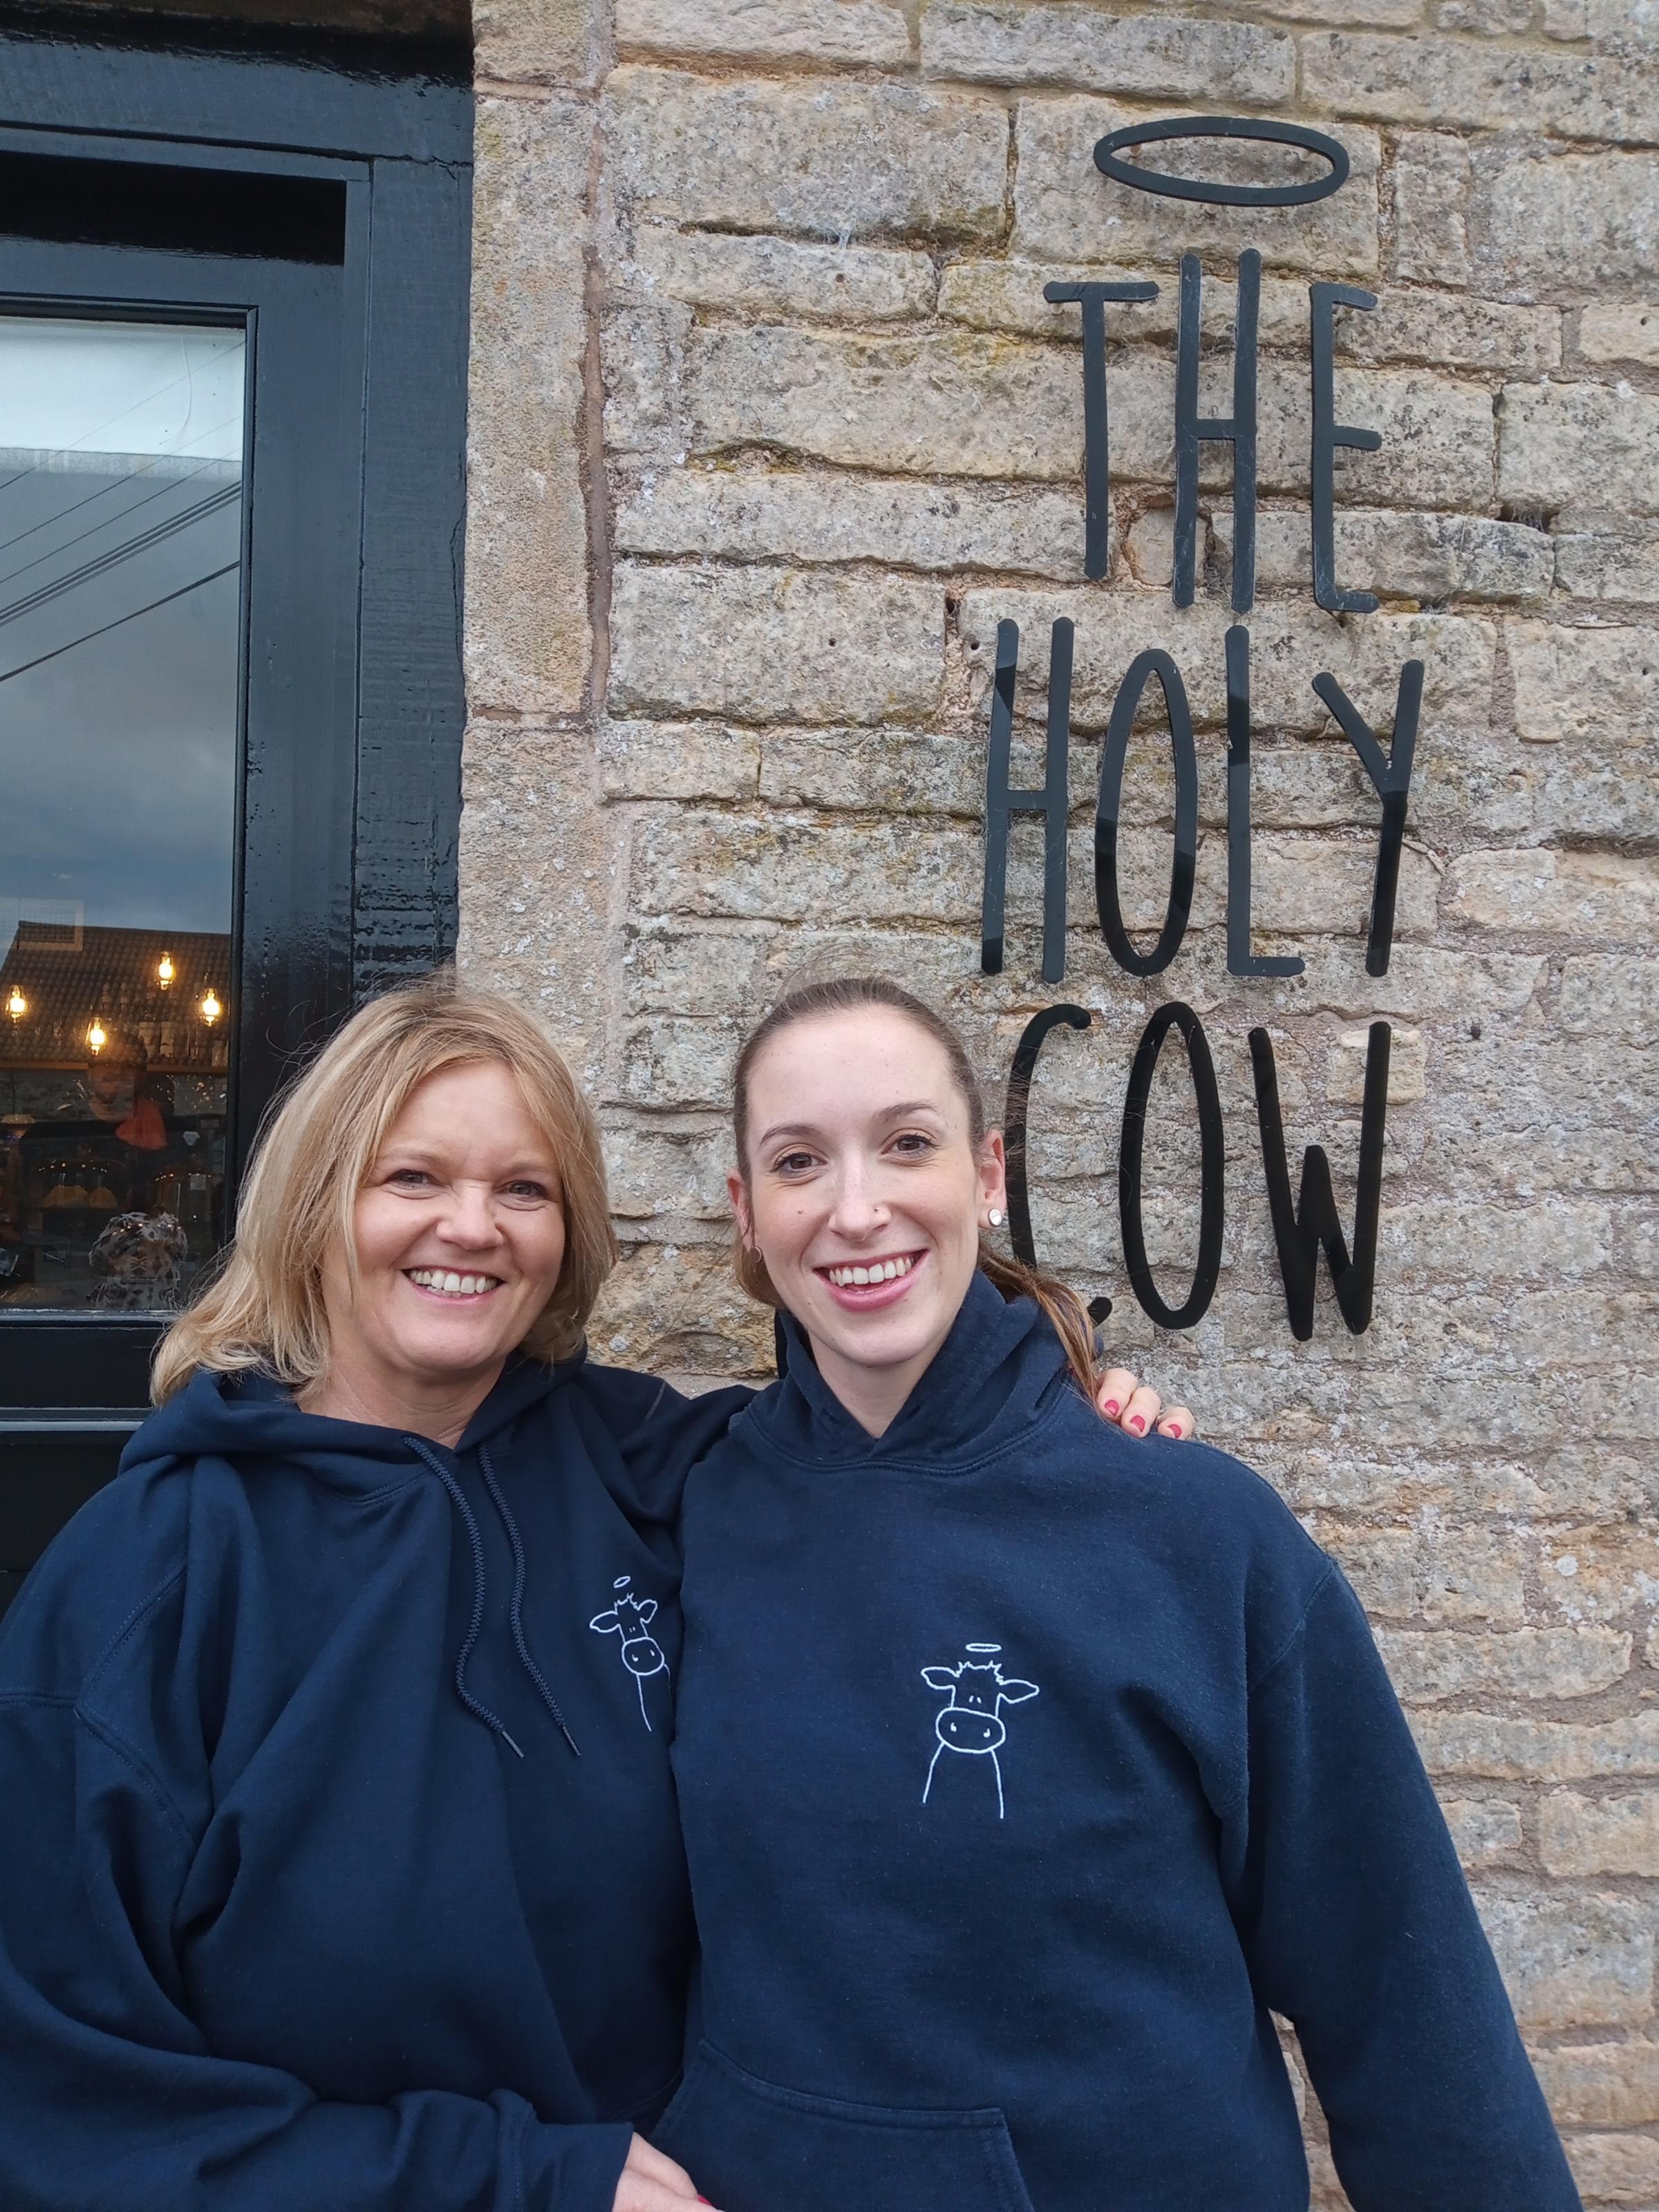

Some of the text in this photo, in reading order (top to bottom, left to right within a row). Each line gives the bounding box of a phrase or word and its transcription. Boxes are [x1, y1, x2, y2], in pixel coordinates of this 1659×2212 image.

[1043, 248, 1382, 613] THE
[982, 617, 1425, 983] HOLY
[1005, 1002, 1391, 1342] COW
